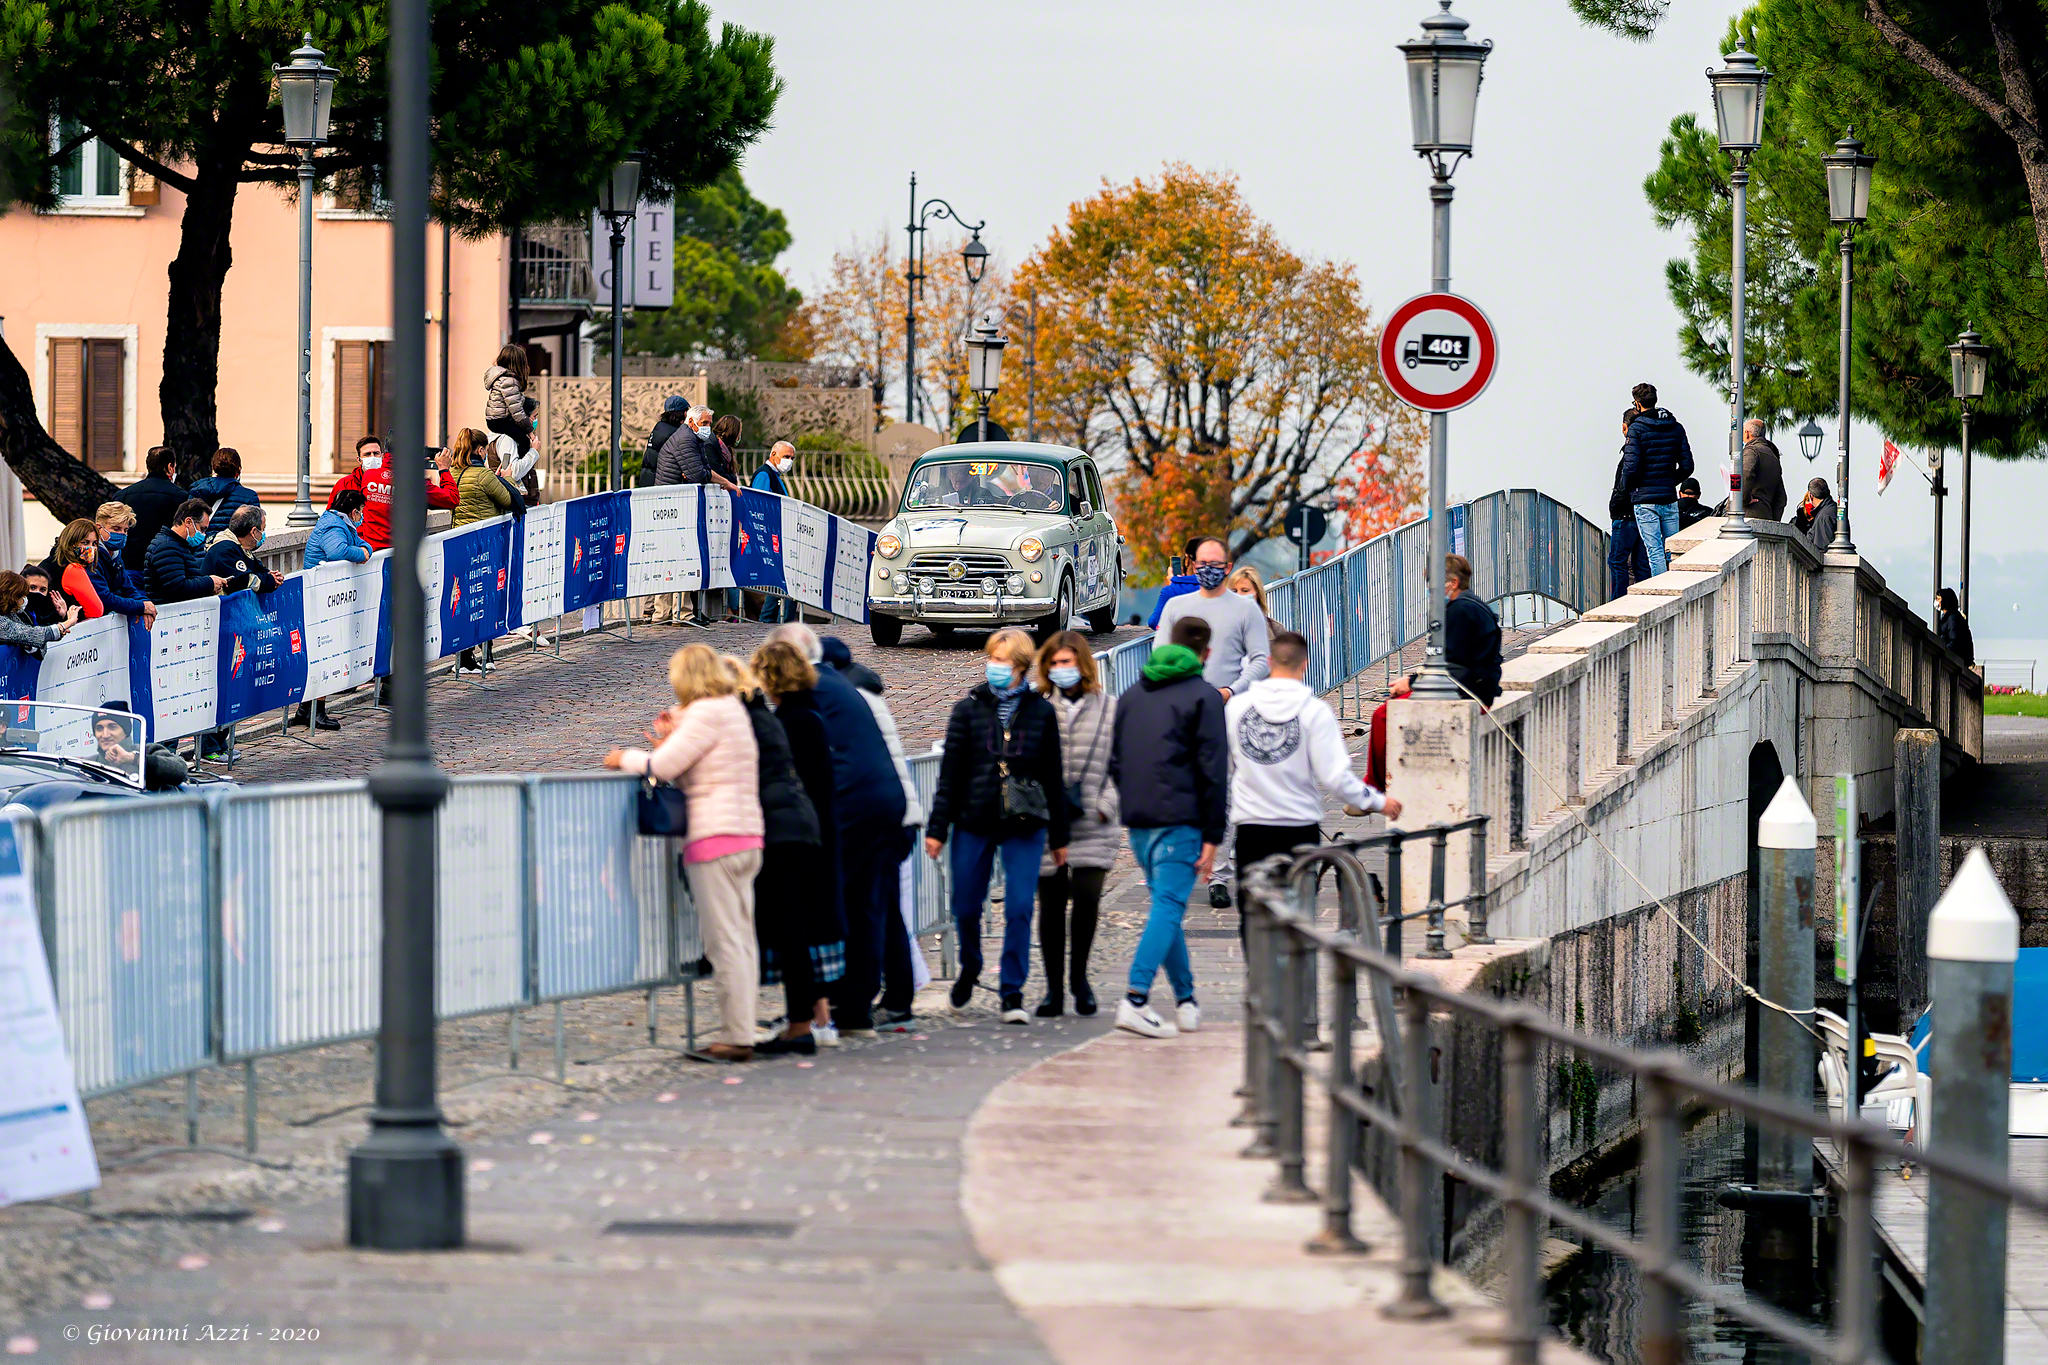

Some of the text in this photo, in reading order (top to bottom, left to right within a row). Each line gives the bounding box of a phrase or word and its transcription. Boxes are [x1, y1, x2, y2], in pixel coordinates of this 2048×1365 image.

[645, 211, 665, 291] TEL
[1428, 338, 1462, 355] 40t
[969, 462, 999, 476] 317
[652, 508, 679, 521] CHOPARD
[796, 522, 815, 538] CHOPARD
[327, 589, 358, 608] CHOPARD
[942, 590, 975, 598] DZ-17-93
[257, 644, 272, 655] RACE
[66, 648, 99, 669] CHOPARD
